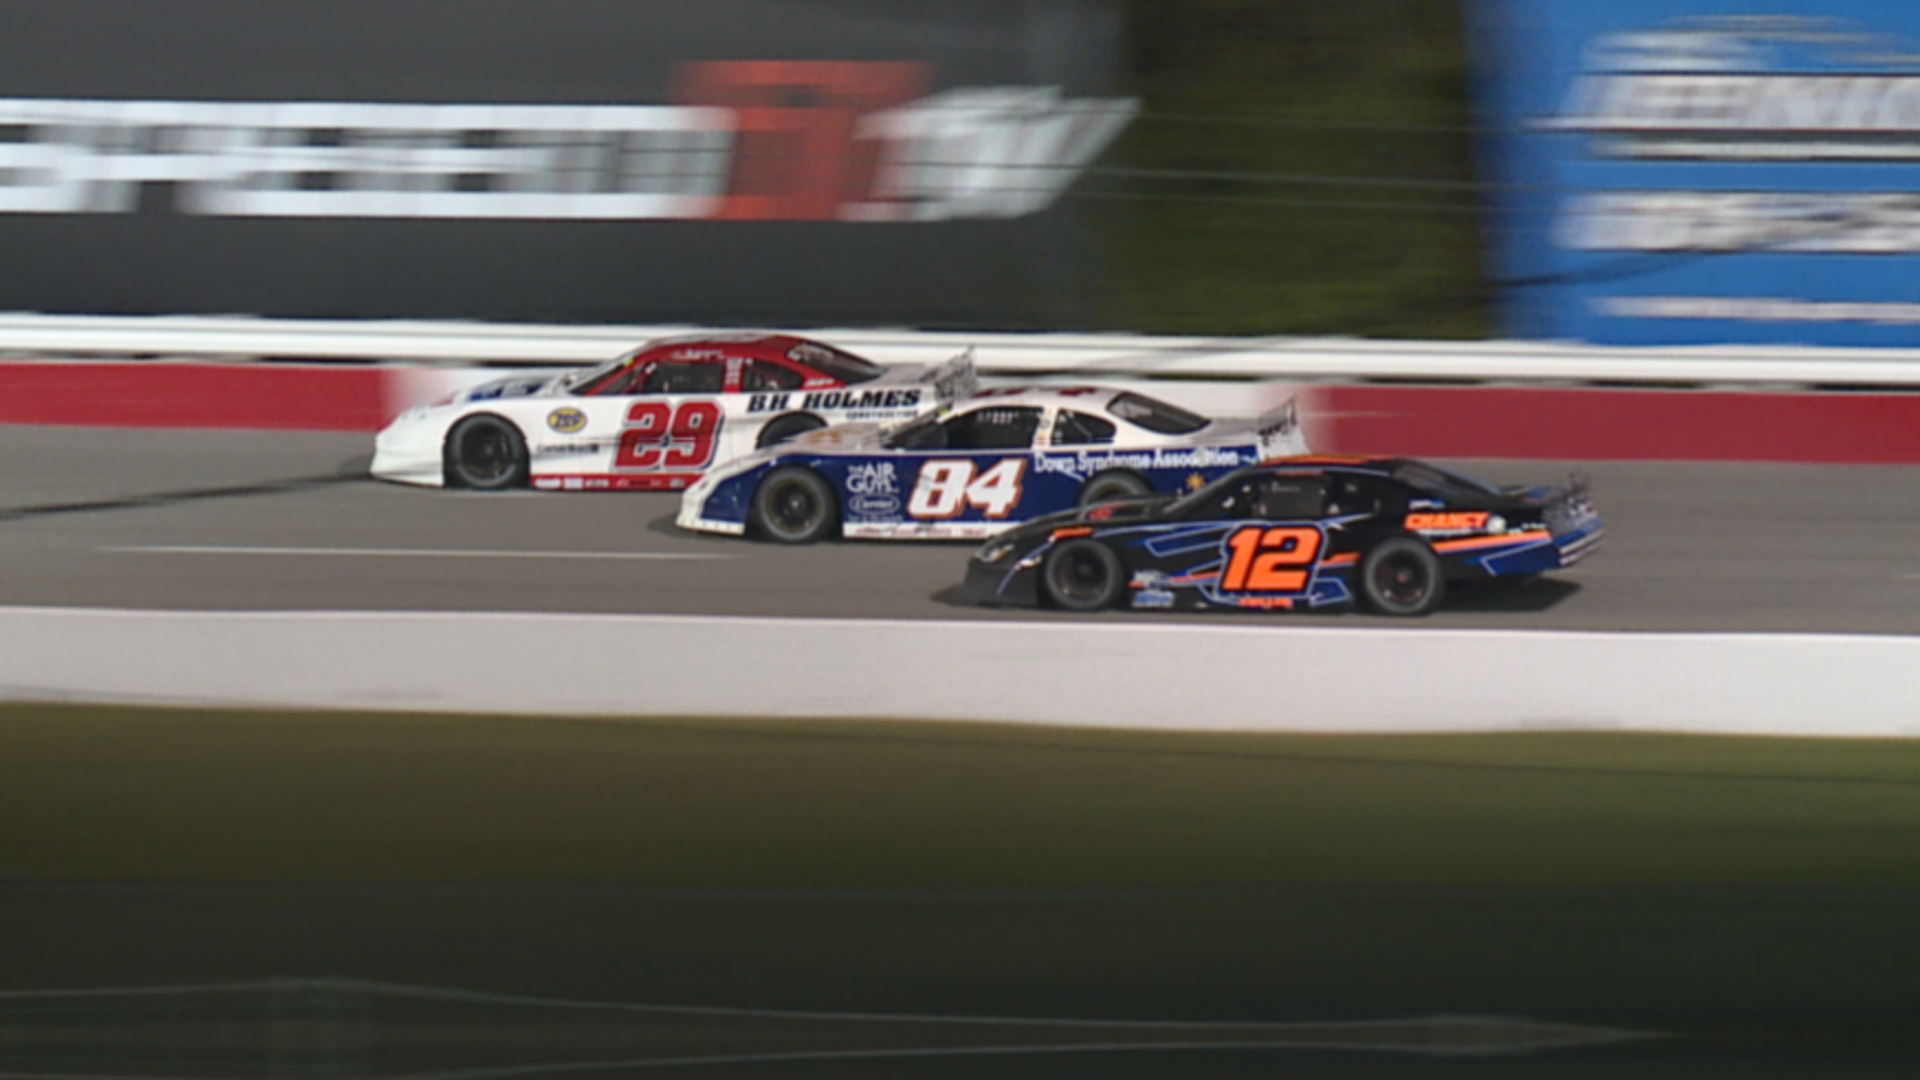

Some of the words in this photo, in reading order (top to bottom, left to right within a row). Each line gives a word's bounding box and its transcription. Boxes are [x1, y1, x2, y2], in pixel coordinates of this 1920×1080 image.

[802, 388, 922, 410] HOLMES
[611, 399, 722, 471] 29
[864, 462, 897, 480] AIR
[1034, 453, 1075, 473] Down
[1078, 450, 1150, 476] Syndrome
[1153, 446, 1239, 468] Assoction
[907, 458, 1027, 519] 84
[1222, 527, 1322, 591] 12
